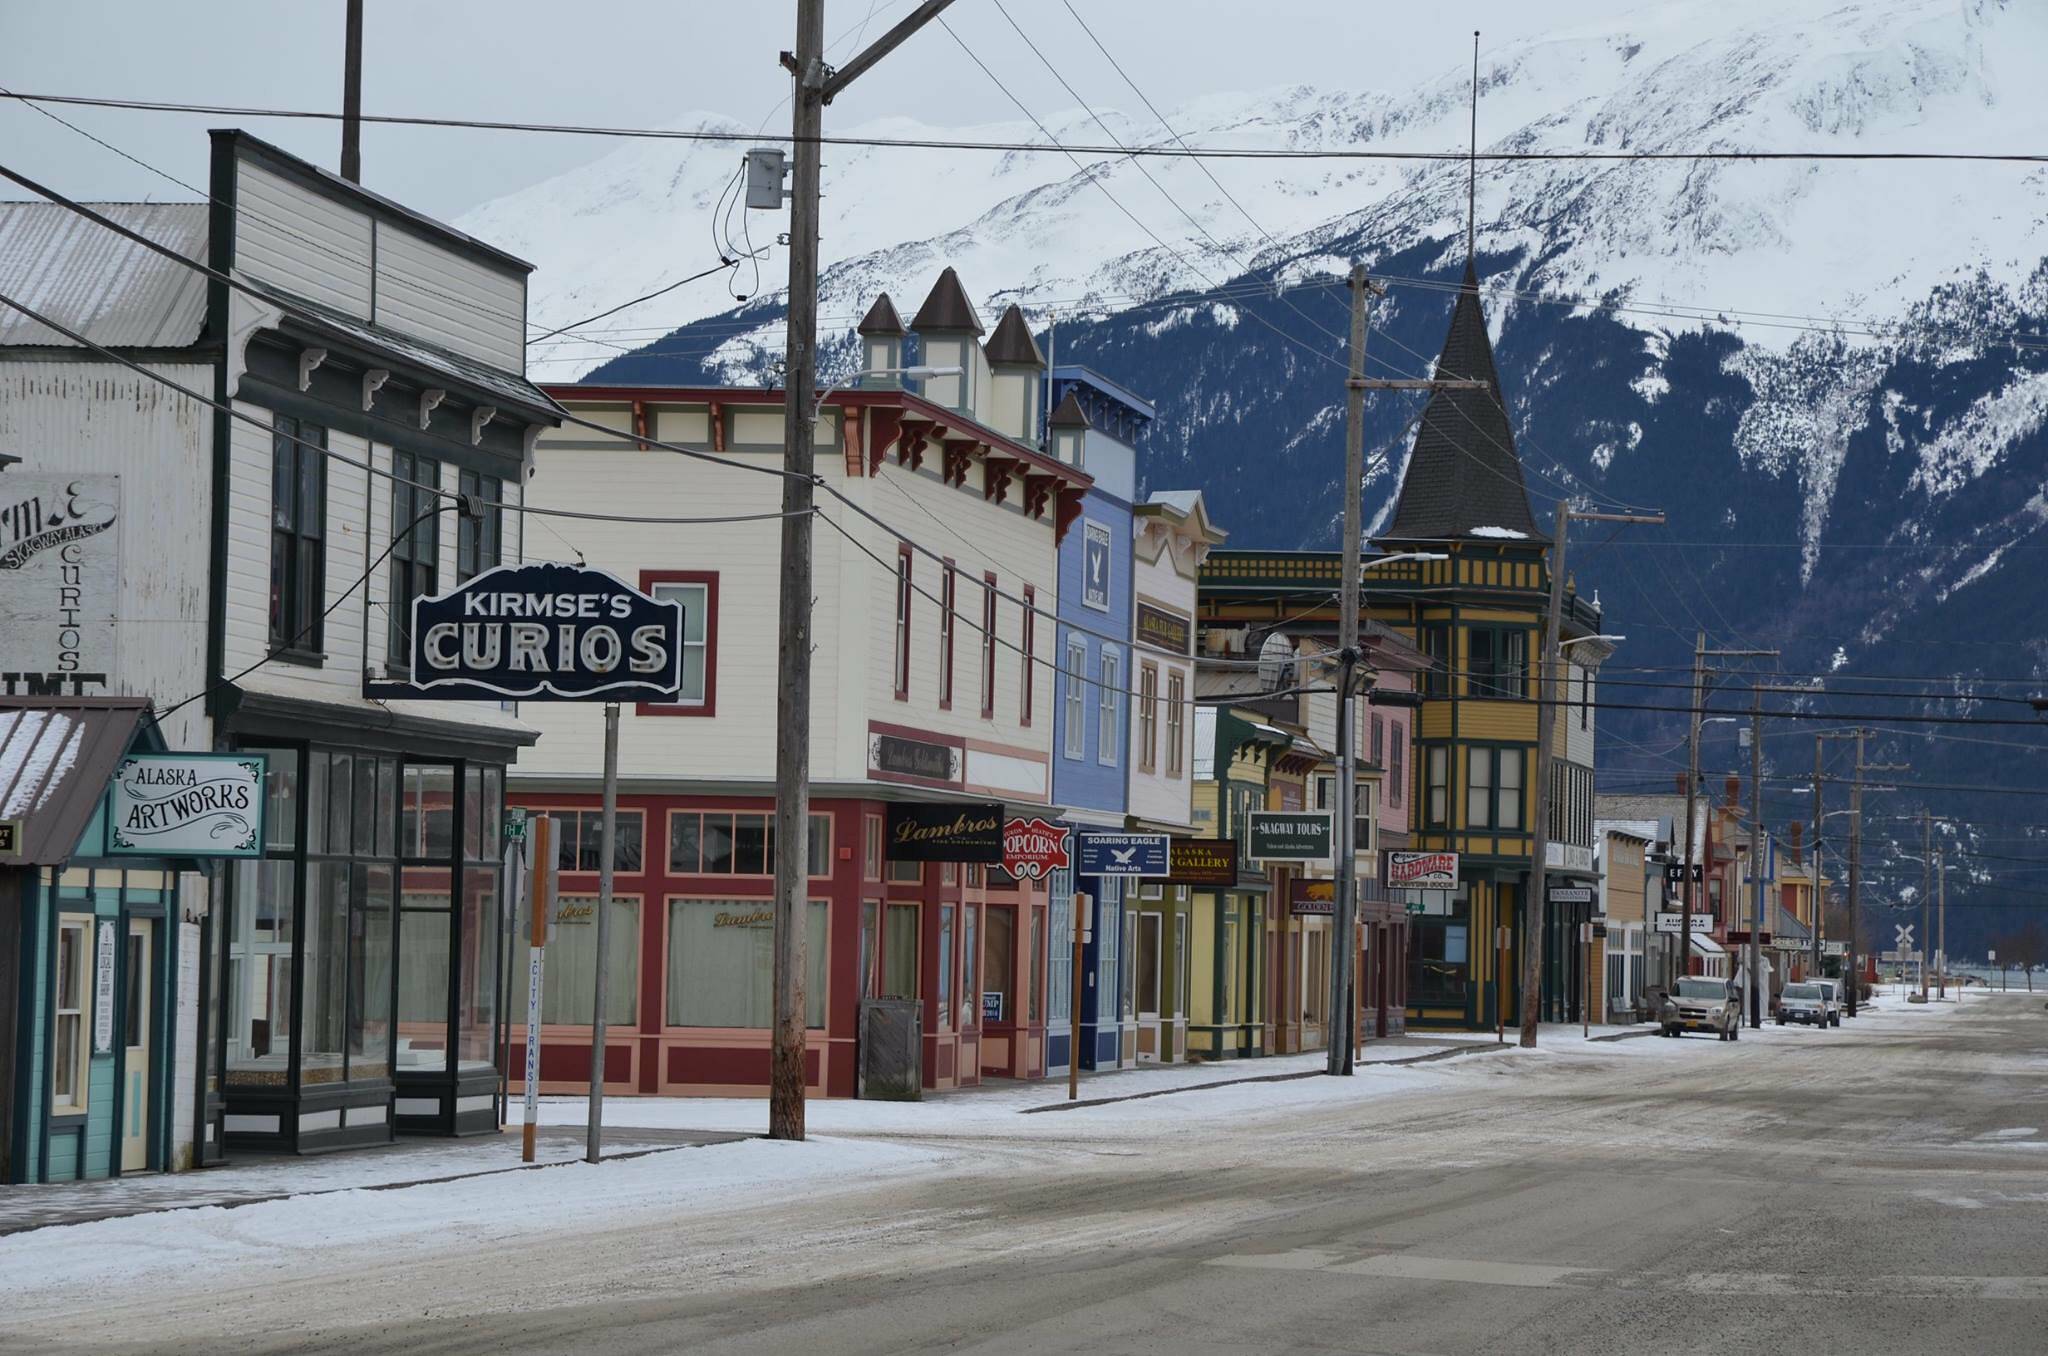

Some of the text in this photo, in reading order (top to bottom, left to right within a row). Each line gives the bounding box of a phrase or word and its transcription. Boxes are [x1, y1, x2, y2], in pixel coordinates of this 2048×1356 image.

[58, 544, 82, 672] CURIOS
[464, 591, 633, 618] KIRMSE'S
[423, 622, 668, 673] CURIOS
[135, 767, 198, 787] ALASKA
[126, 784, 249, 829] ARTWORKS
[893, 813, 998, 844] Lambros
[1087, 836, 1161, 845] SOARING EAGLE
[1259, 822, 1322, 836] SKAGWAY TOURS
[1105, 864, 1125, 872] Native
[1177, 857, 1230, 868] GALLERY
[1391, 855, 1454, 880] HARDWARE
[1669, 868, 1699, 878] EFY
[1665, 918, 1705, 928] AURRA
[530, 964, 539, 1011] CITY
[526, 1024, 536, 1106] TRANSIT
